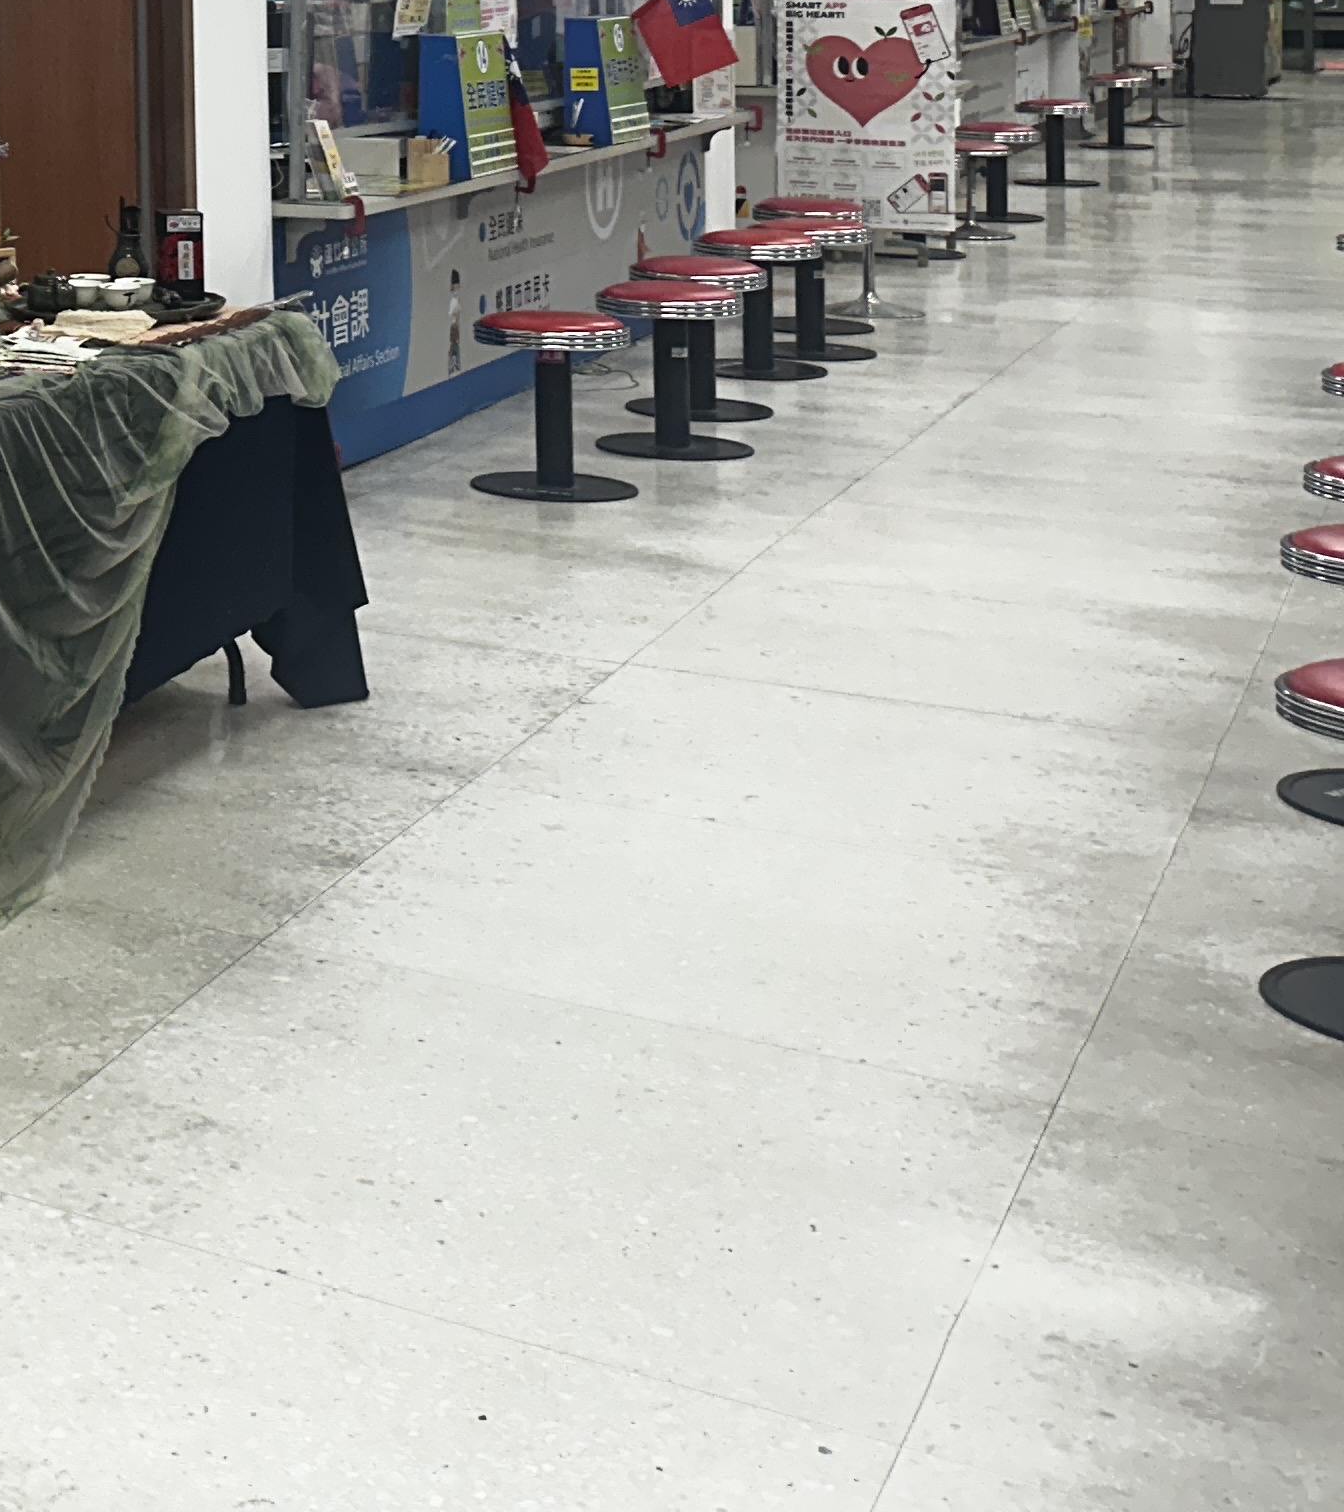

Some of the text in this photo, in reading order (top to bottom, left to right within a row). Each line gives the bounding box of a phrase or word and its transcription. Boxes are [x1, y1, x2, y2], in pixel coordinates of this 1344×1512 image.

[785, 1, 847, 10] SMART APP
[785, 10, 803, 19] BIG
[312, 287, 370, 349] 社會課
